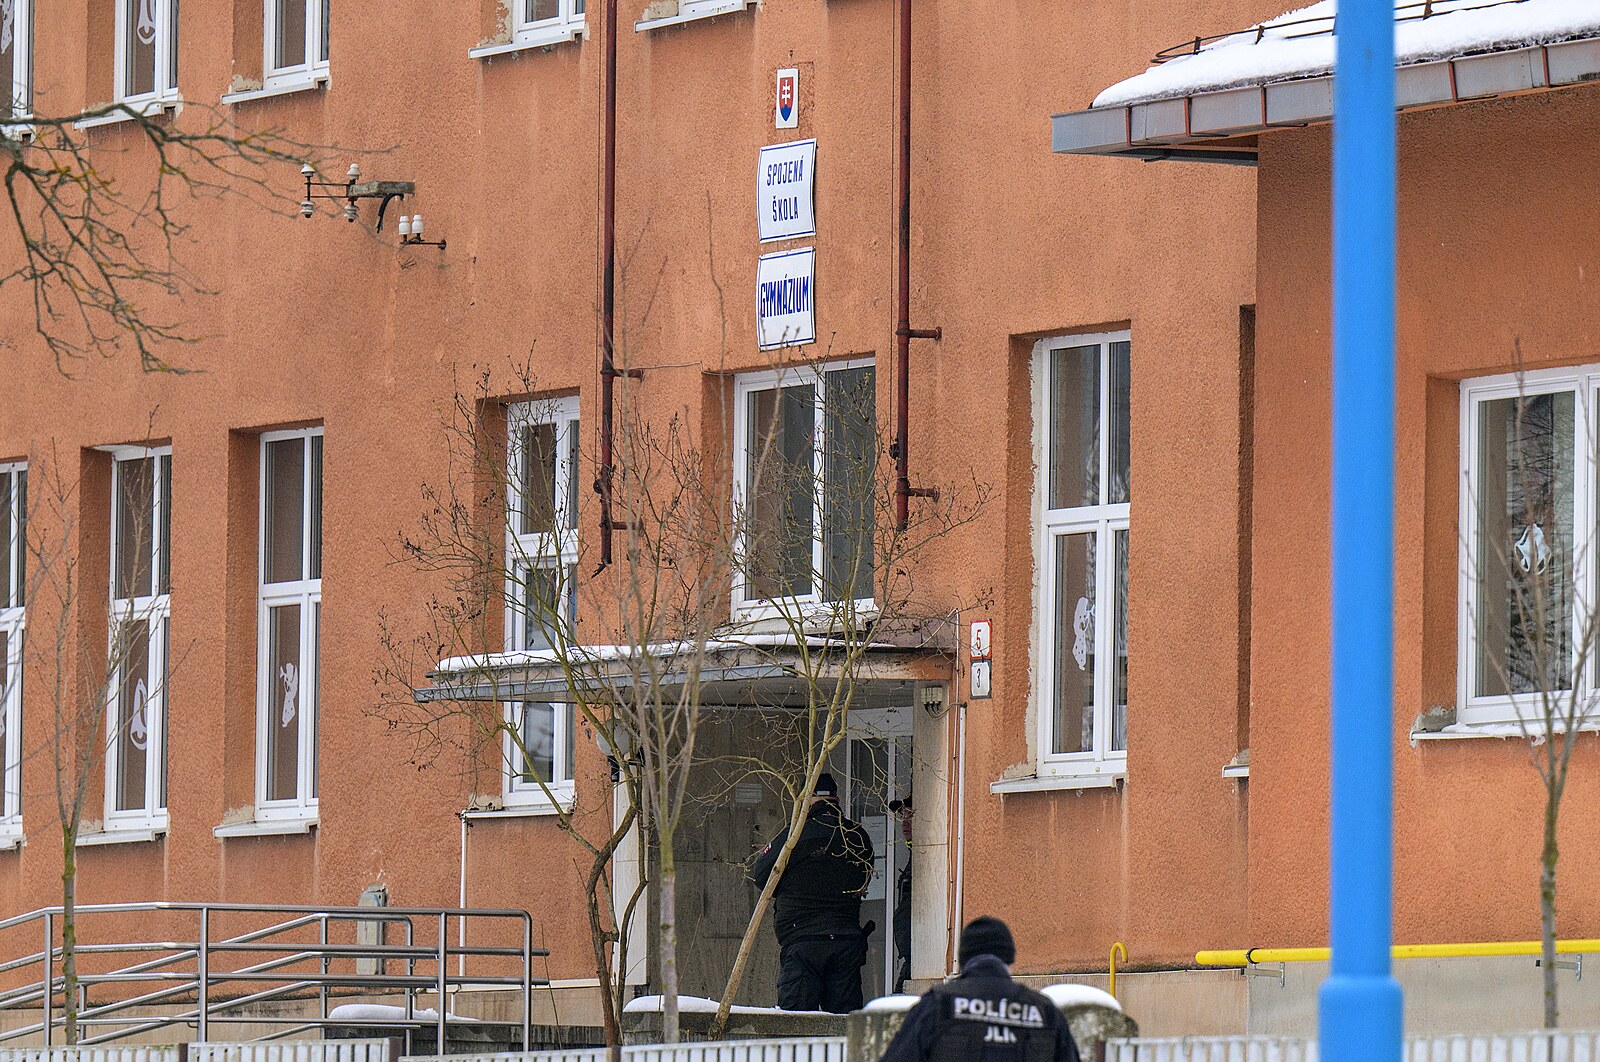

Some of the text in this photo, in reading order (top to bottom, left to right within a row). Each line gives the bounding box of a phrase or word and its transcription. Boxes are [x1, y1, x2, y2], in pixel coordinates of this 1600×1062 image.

[766, 155, 804, 187] SPOJENÁ
[772, 195, 799, 222] ŠKOLA
[760, 273, 809, 318] GYMNÁZIUM
[976, 628, 982, 651] 5
[954, 997, 1044, 1022] POLÍCIA
